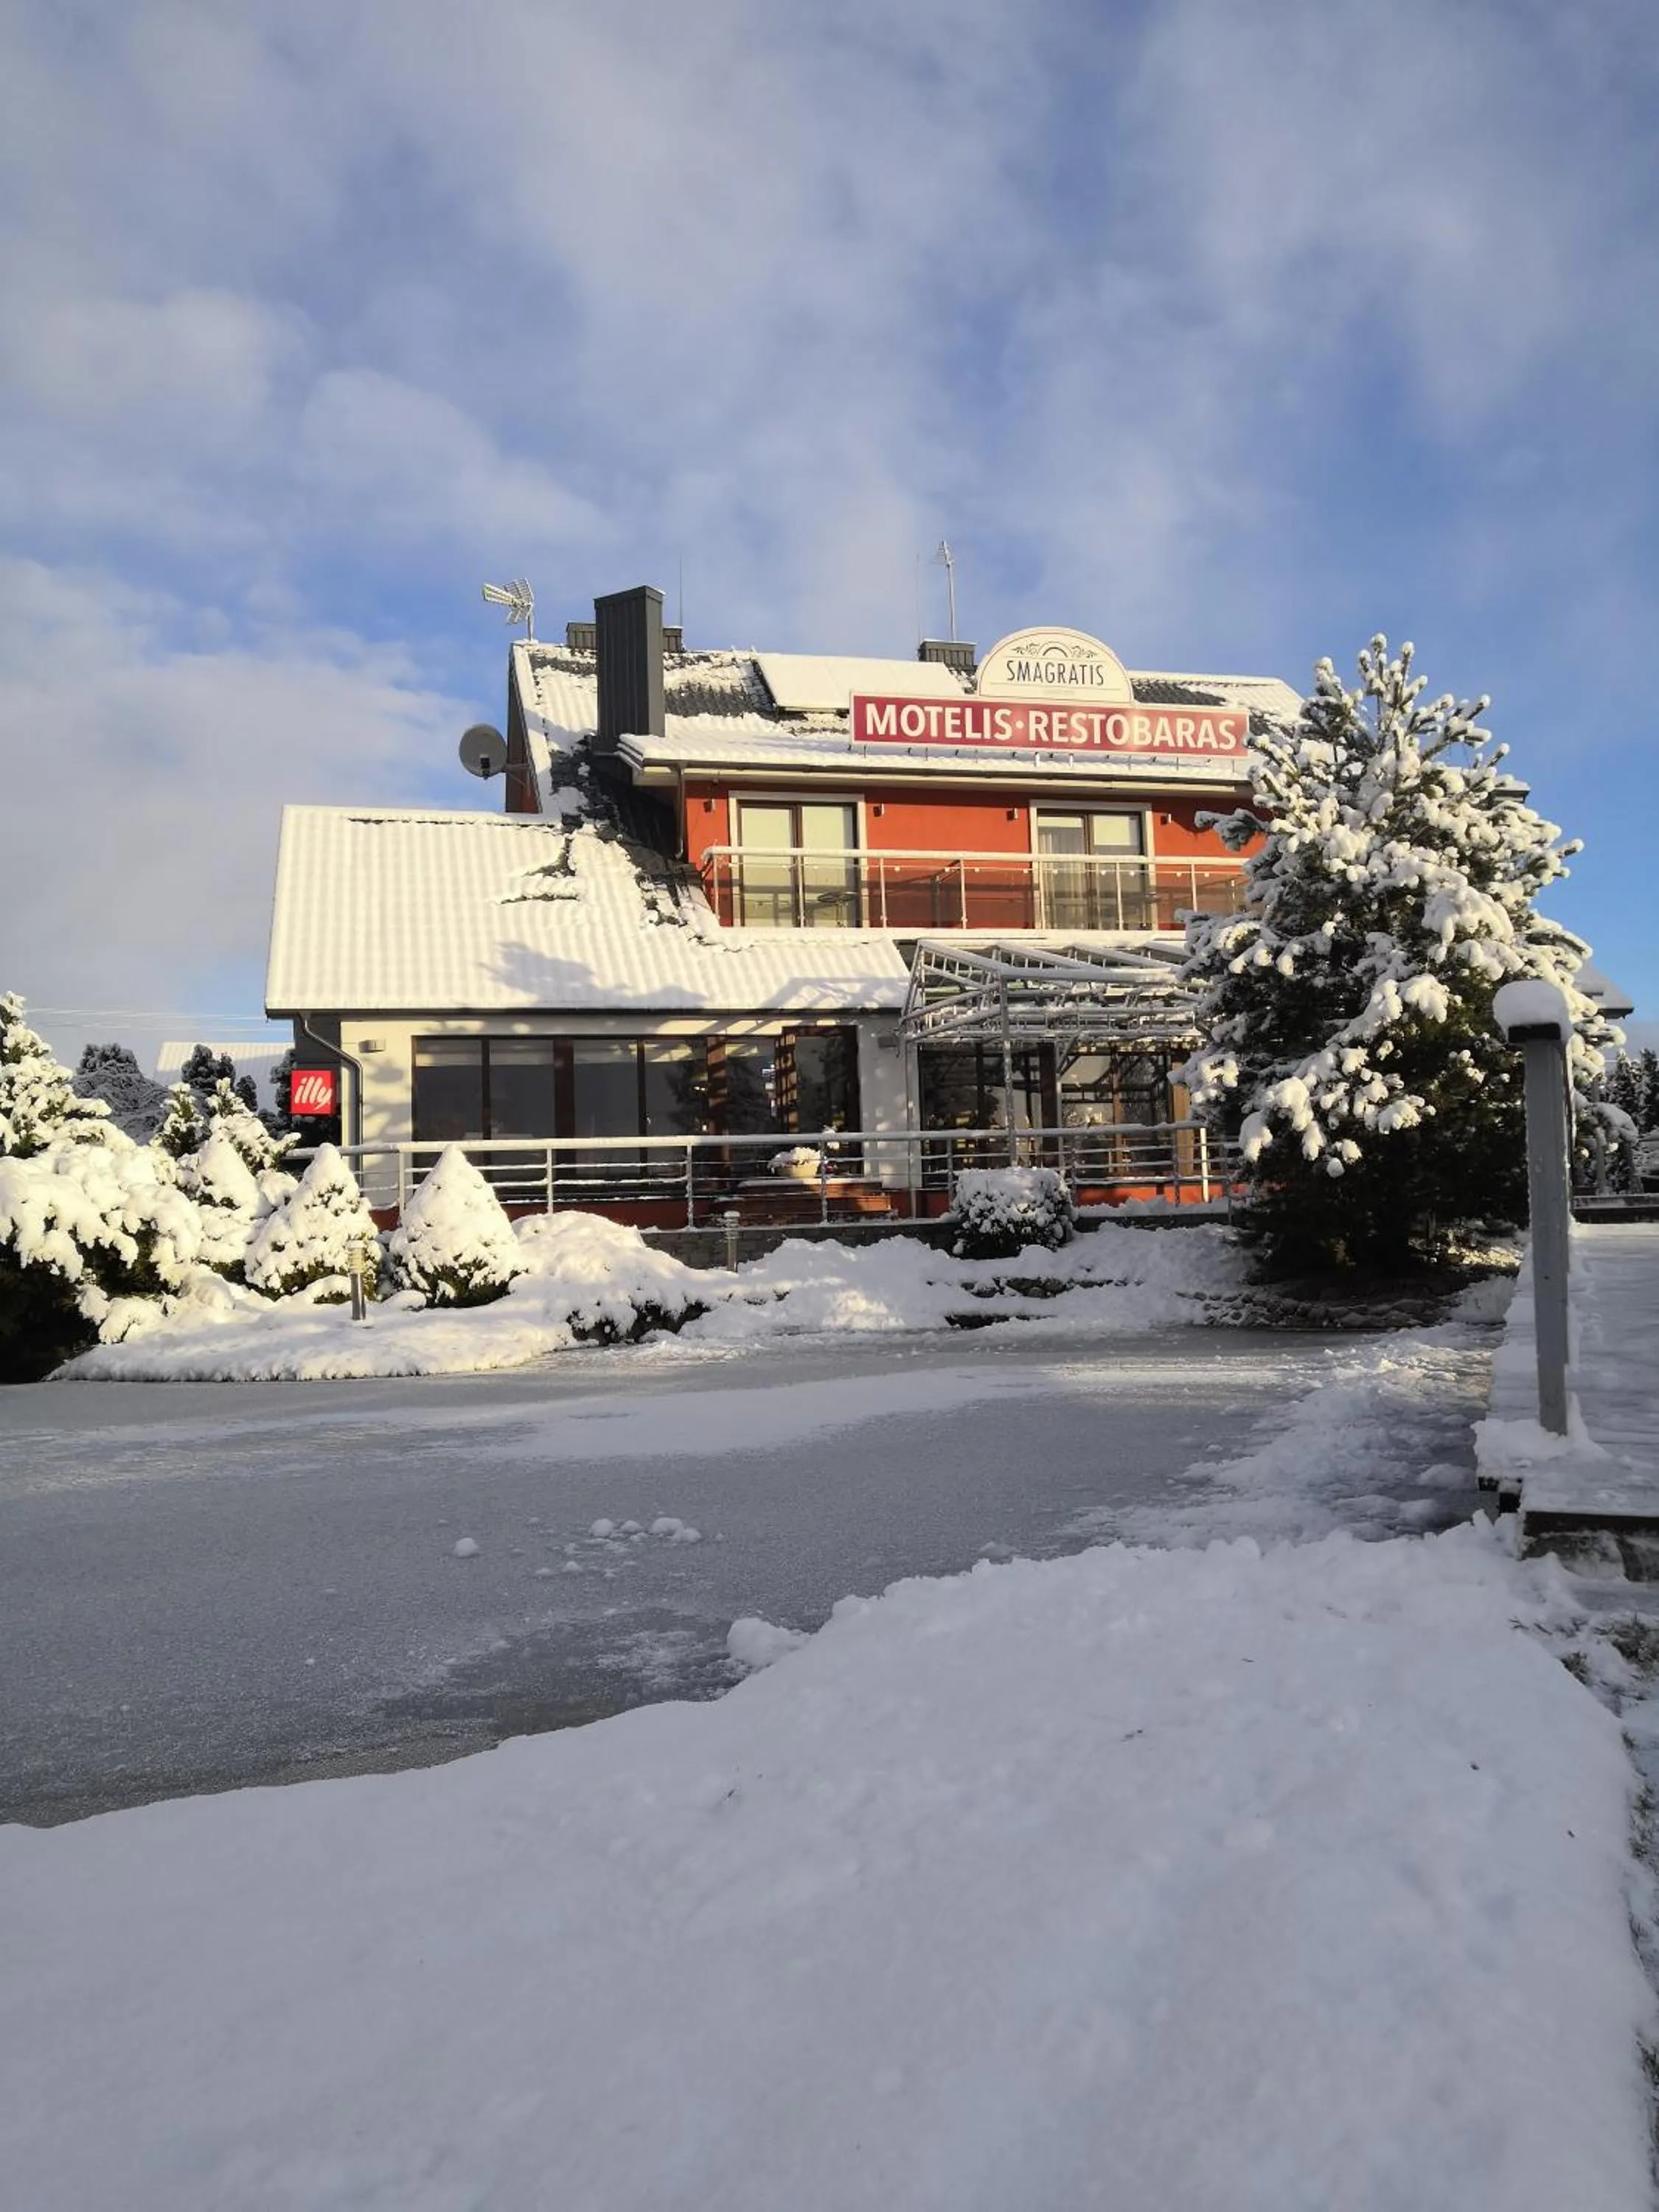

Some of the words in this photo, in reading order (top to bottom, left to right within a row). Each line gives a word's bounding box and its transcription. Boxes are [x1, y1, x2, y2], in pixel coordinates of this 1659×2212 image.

[1006, 660, 1105, 686] SMAGRATIS
[865, 703, 1013, 741] MOTELIS
[1028, 709, 1237, 751] RESTOBARAS
[294, 1076, 333, 1111] illy
